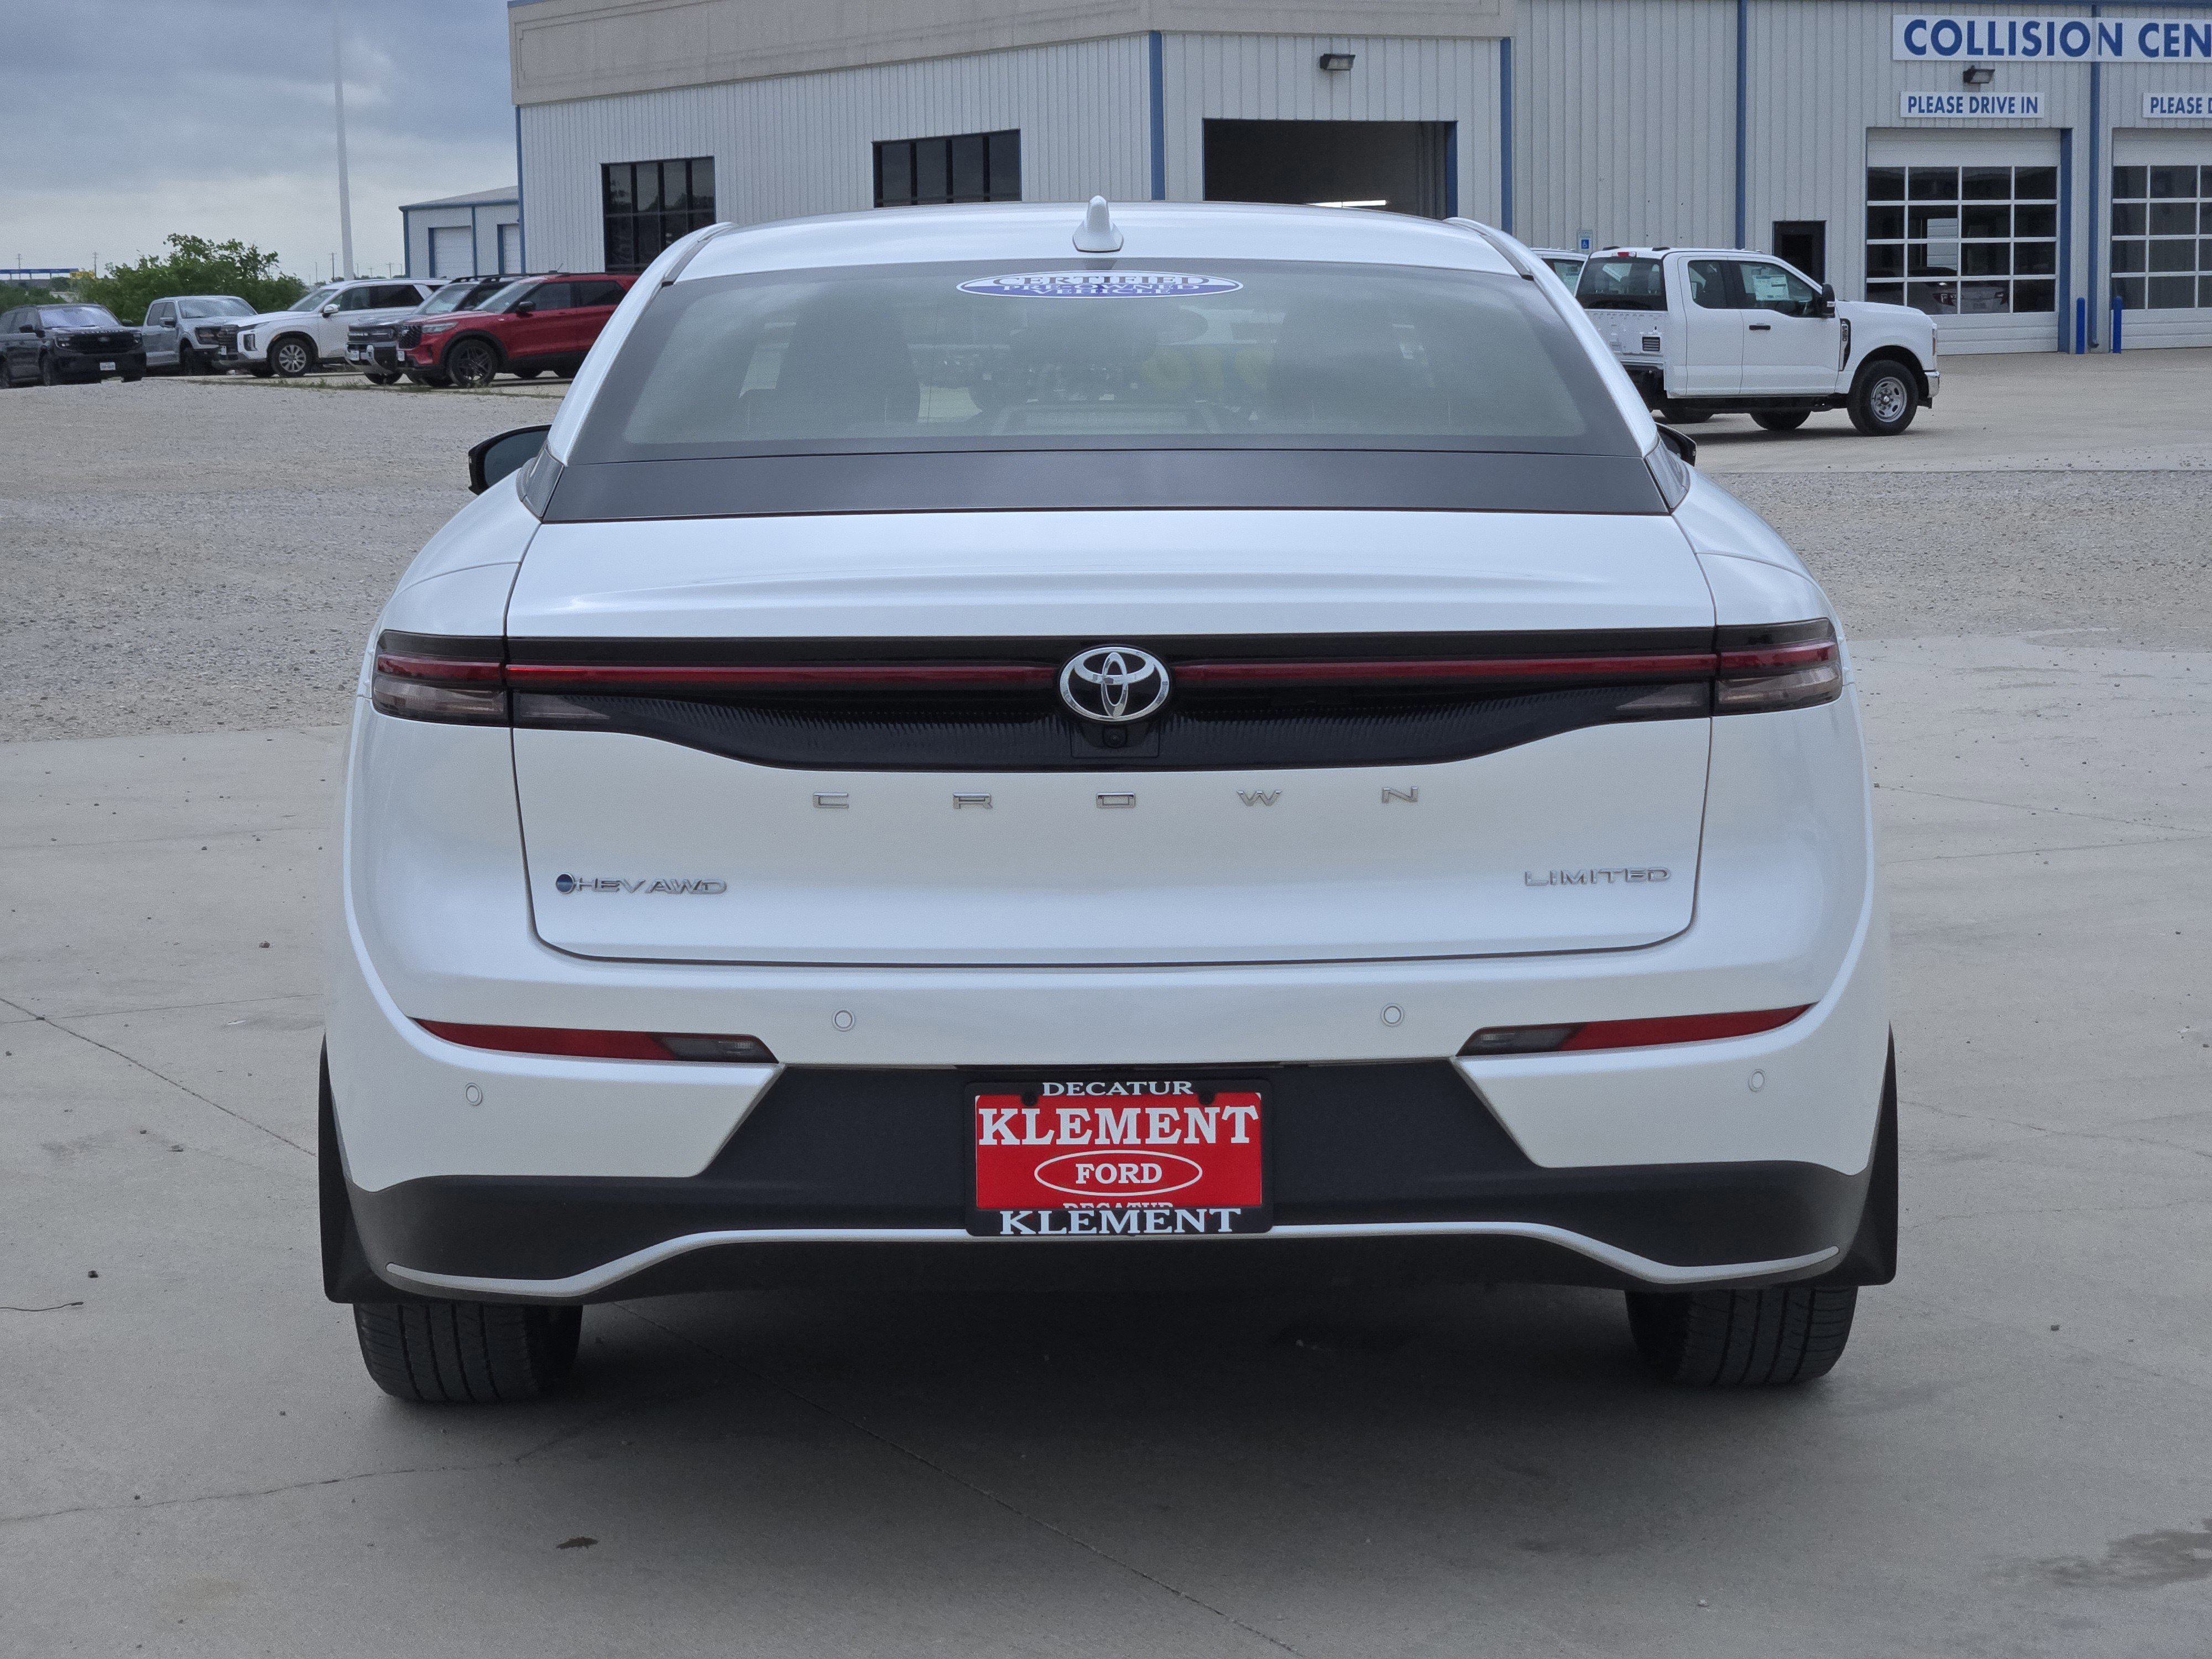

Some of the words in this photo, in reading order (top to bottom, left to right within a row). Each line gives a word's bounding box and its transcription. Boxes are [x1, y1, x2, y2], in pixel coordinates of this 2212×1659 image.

[1903, 19, 2122, 57] COLLISION
[2138, 23, 2211, 58] CEN
[1908, 96, 1963, 114] PLEASE
[1969, 96, 2016, 114] DRIVE
[2021, 96, 2038, 114] IN
[2150, 96, 2203, 114] PLEASE
[993, 276, 1209, 285] CERTIFIED
[812, 786, 1419, 810] CROWN
[1525, 867, 1671, 886] LIMITED
[1042, 1081, 1193, 1096] DECATUR
[978, 1105, 1259, 1145] KLEMENT
[1076, 1163, 1162, 1184] FORD
[1000, 1208, 1241, 1234] KLEMENT
